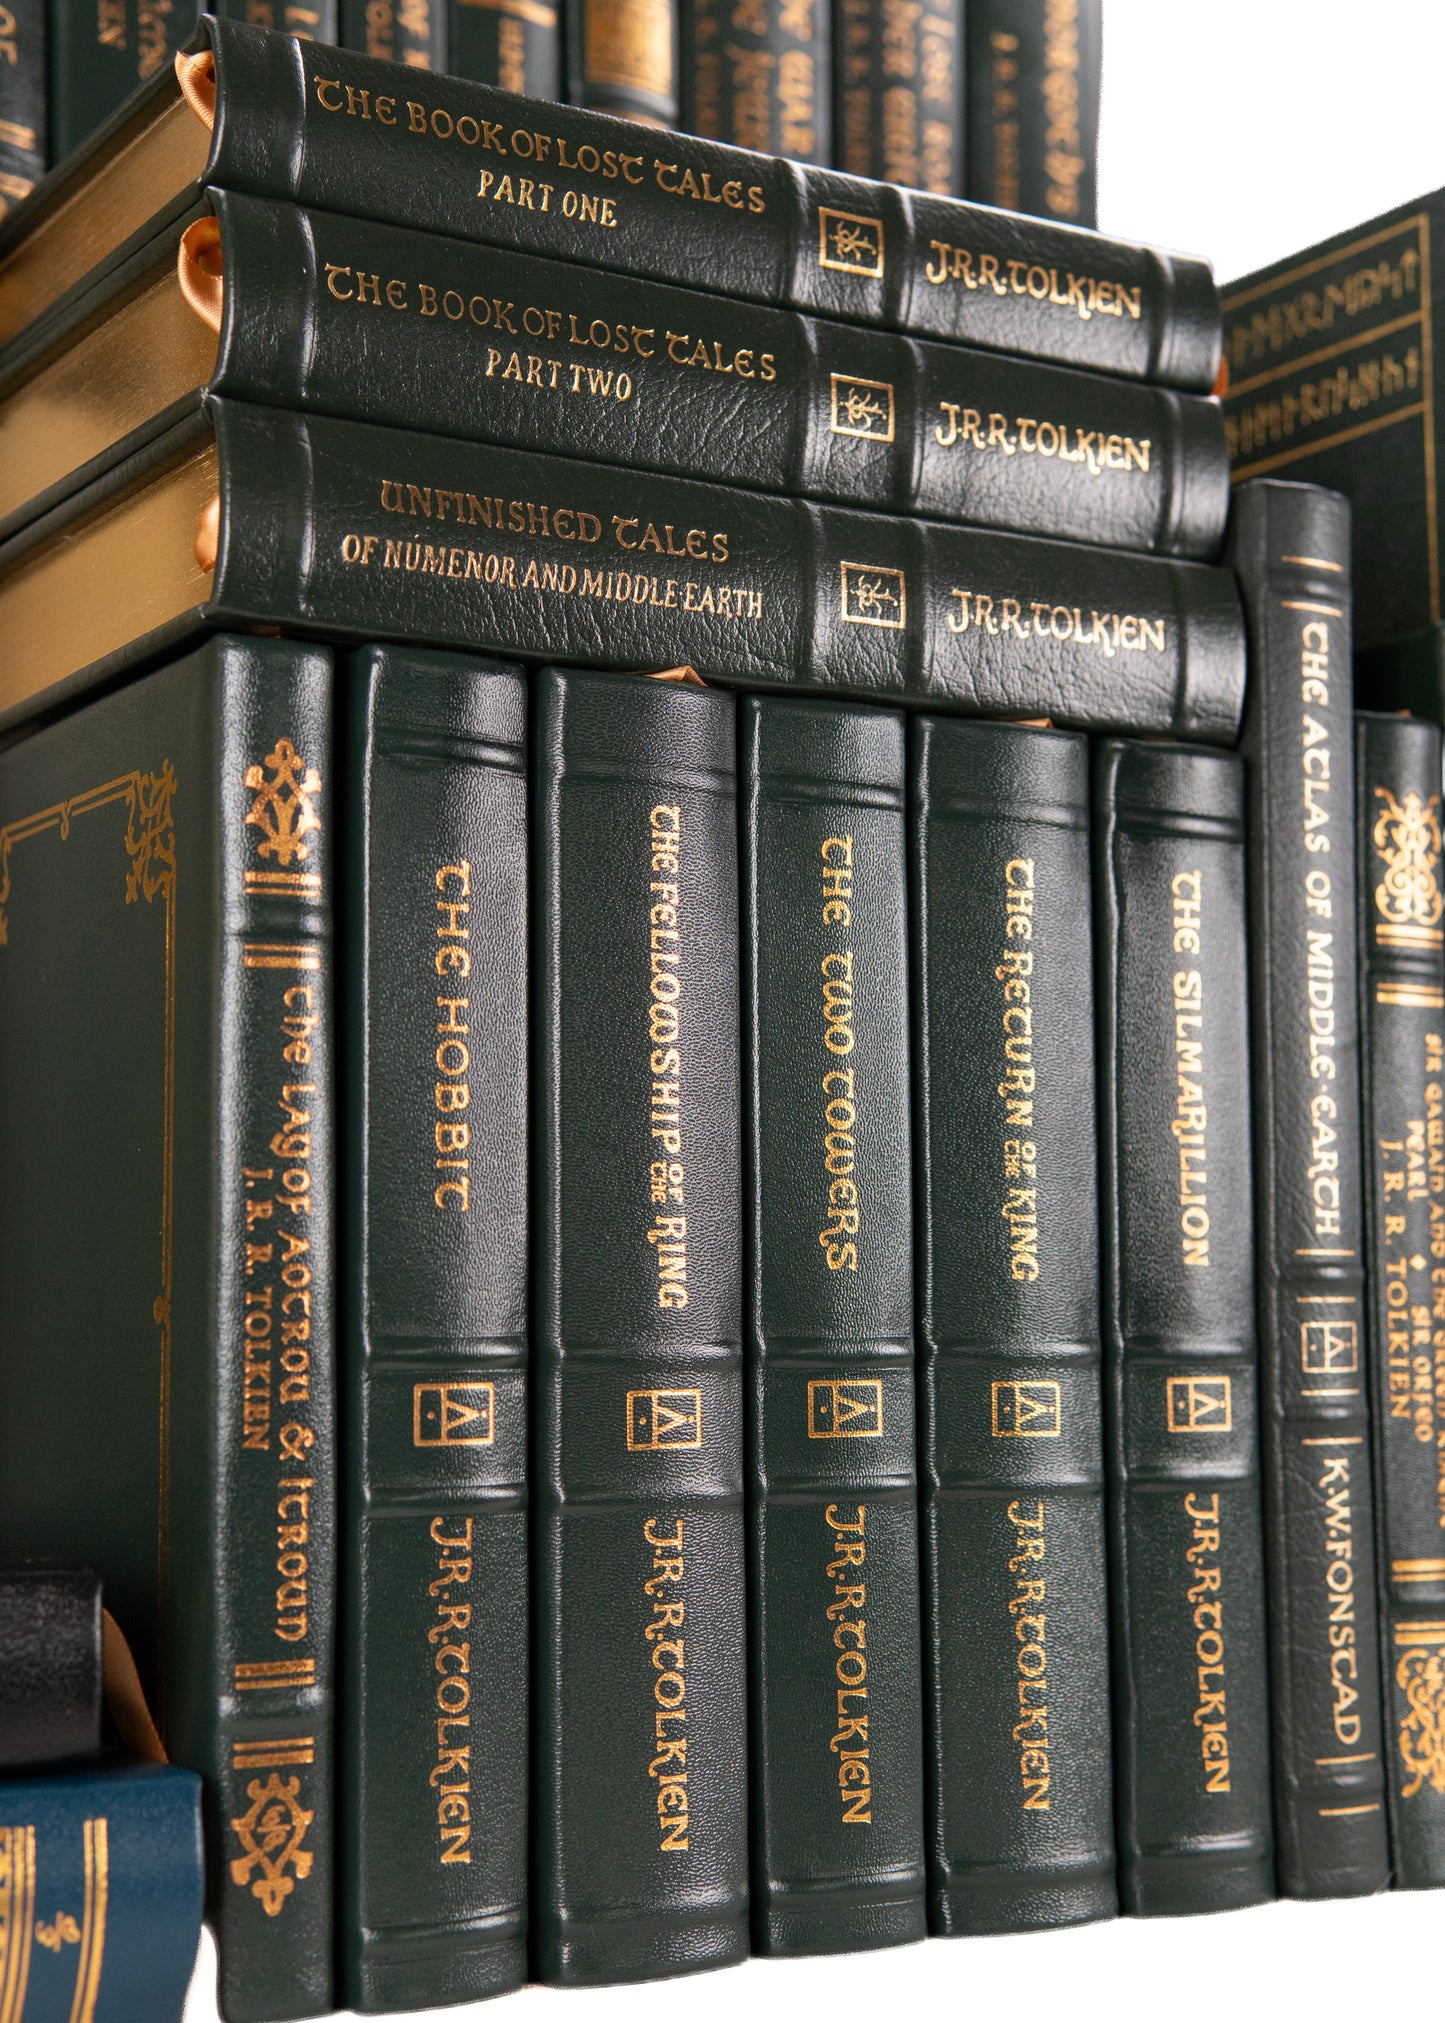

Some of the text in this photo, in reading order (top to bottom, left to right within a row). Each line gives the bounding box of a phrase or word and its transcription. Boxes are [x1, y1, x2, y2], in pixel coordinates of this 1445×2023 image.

[313, 75, 766, 214] THE BOOK OF LOST TALES
[477, 170, 618, 228] PART ONE
[324, 263, 777, 382] THE BOOK OF LOST TALES
[485, 348, 633, 403] PART TWO
[342, 533, 379, 565] OF
[522, 560, 578, 595] AND
[381, 480, 729, 563] UNFINISHED TALES
[1301, 623, 1328, 705] THE
[1302, 716, 1329, 851] ATLAS
[1303, 869, 1332, 917] OF
[433, 859, 472, 1213] THE HOBBIT
[646, 803, 689, 1309] THE FELLOWSHIP OF THE RING
[818, 835, 861, 1271] THE TWO TOWERS
[994, 857, 1040, 1281] THE RETURN OF THE KING
[1170, 870, 1209, 1265] THE SILMARILLION
[1405, 1118, 1433, 1204] PEARL
[241, 1167, 274, 1451] J. R. R. TOLKIEN
[1379, 1139, 1414, 1419] J. R. R. TOLKIEN
[1409, 1305, 1434, 1346] SIR
[278, 1421, 316, 1461] &
